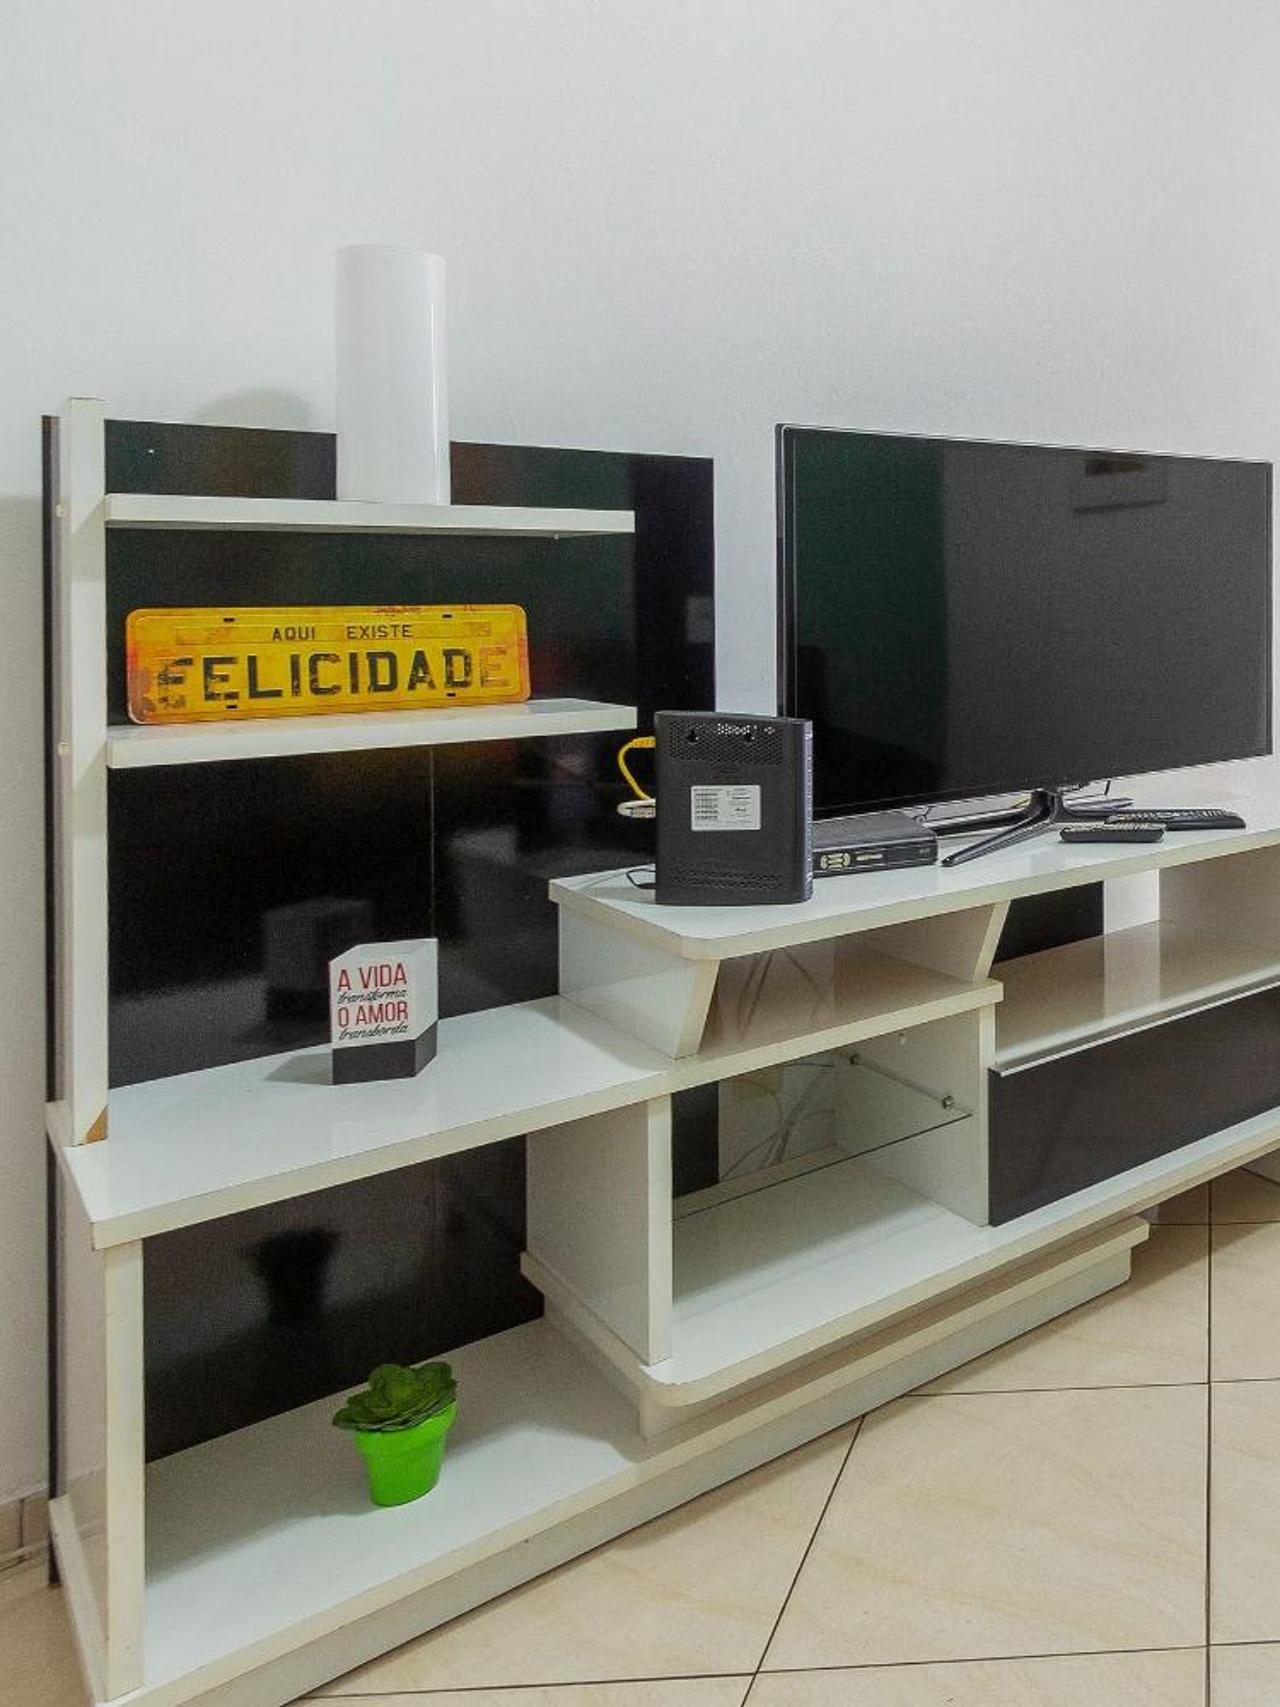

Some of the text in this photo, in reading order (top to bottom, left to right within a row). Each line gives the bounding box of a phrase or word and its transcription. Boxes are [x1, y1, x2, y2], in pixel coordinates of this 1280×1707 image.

[272, 623, 413, 642] AQUI EXISTE
[156, 645, 509, 701] FELICIDADE
[337, 962, 408, 992] A VIDA
[338, 1000, 409, 1028] O AMOR
